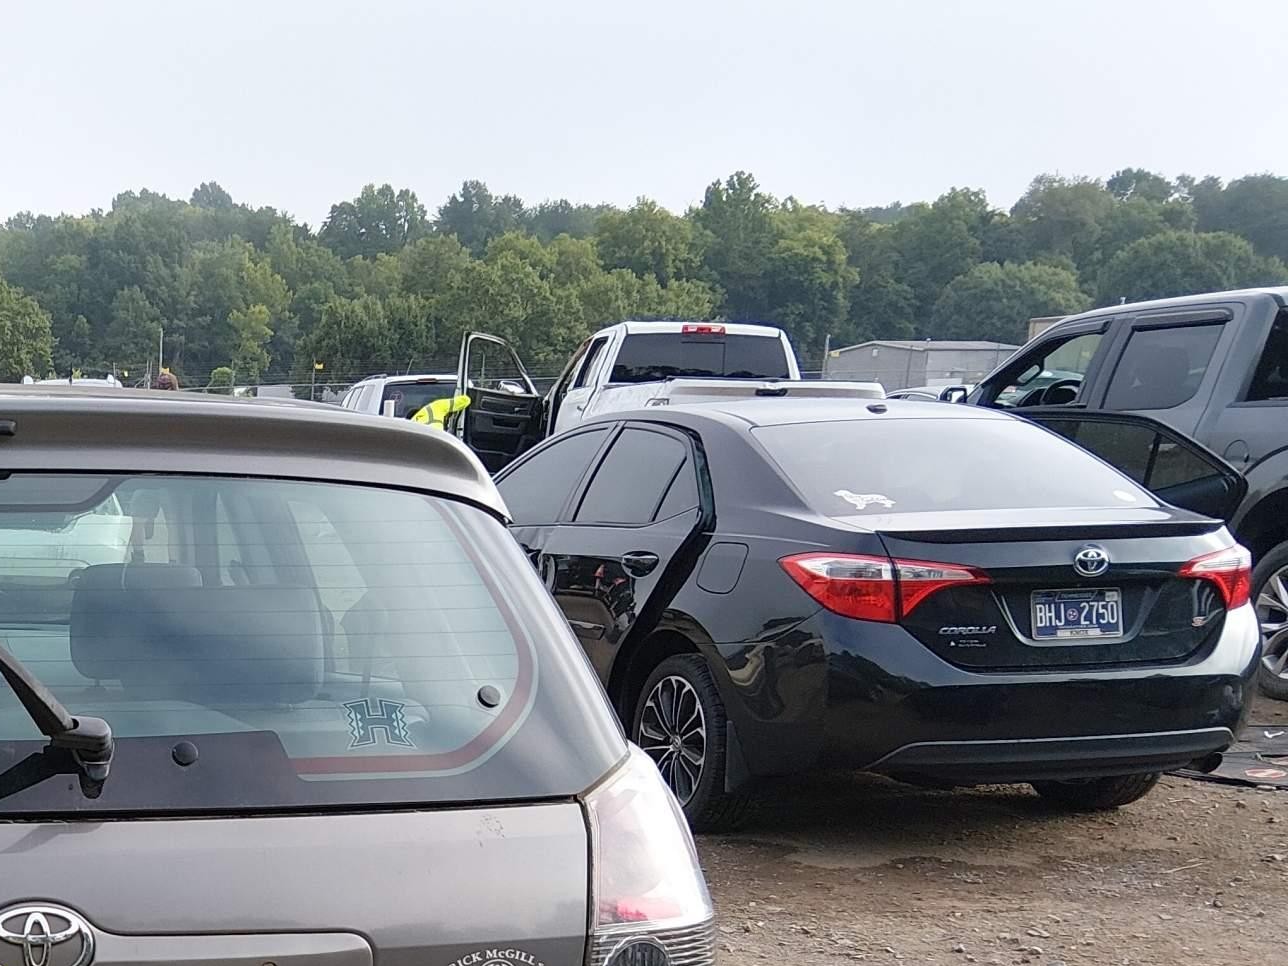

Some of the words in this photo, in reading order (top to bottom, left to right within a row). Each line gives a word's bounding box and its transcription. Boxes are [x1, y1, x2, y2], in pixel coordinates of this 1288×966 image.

[1035, 603, 1066, 628] BHJ
[1079, 601, 1118, 625] 2750
[938, 625, 997, 635] COROLLA
